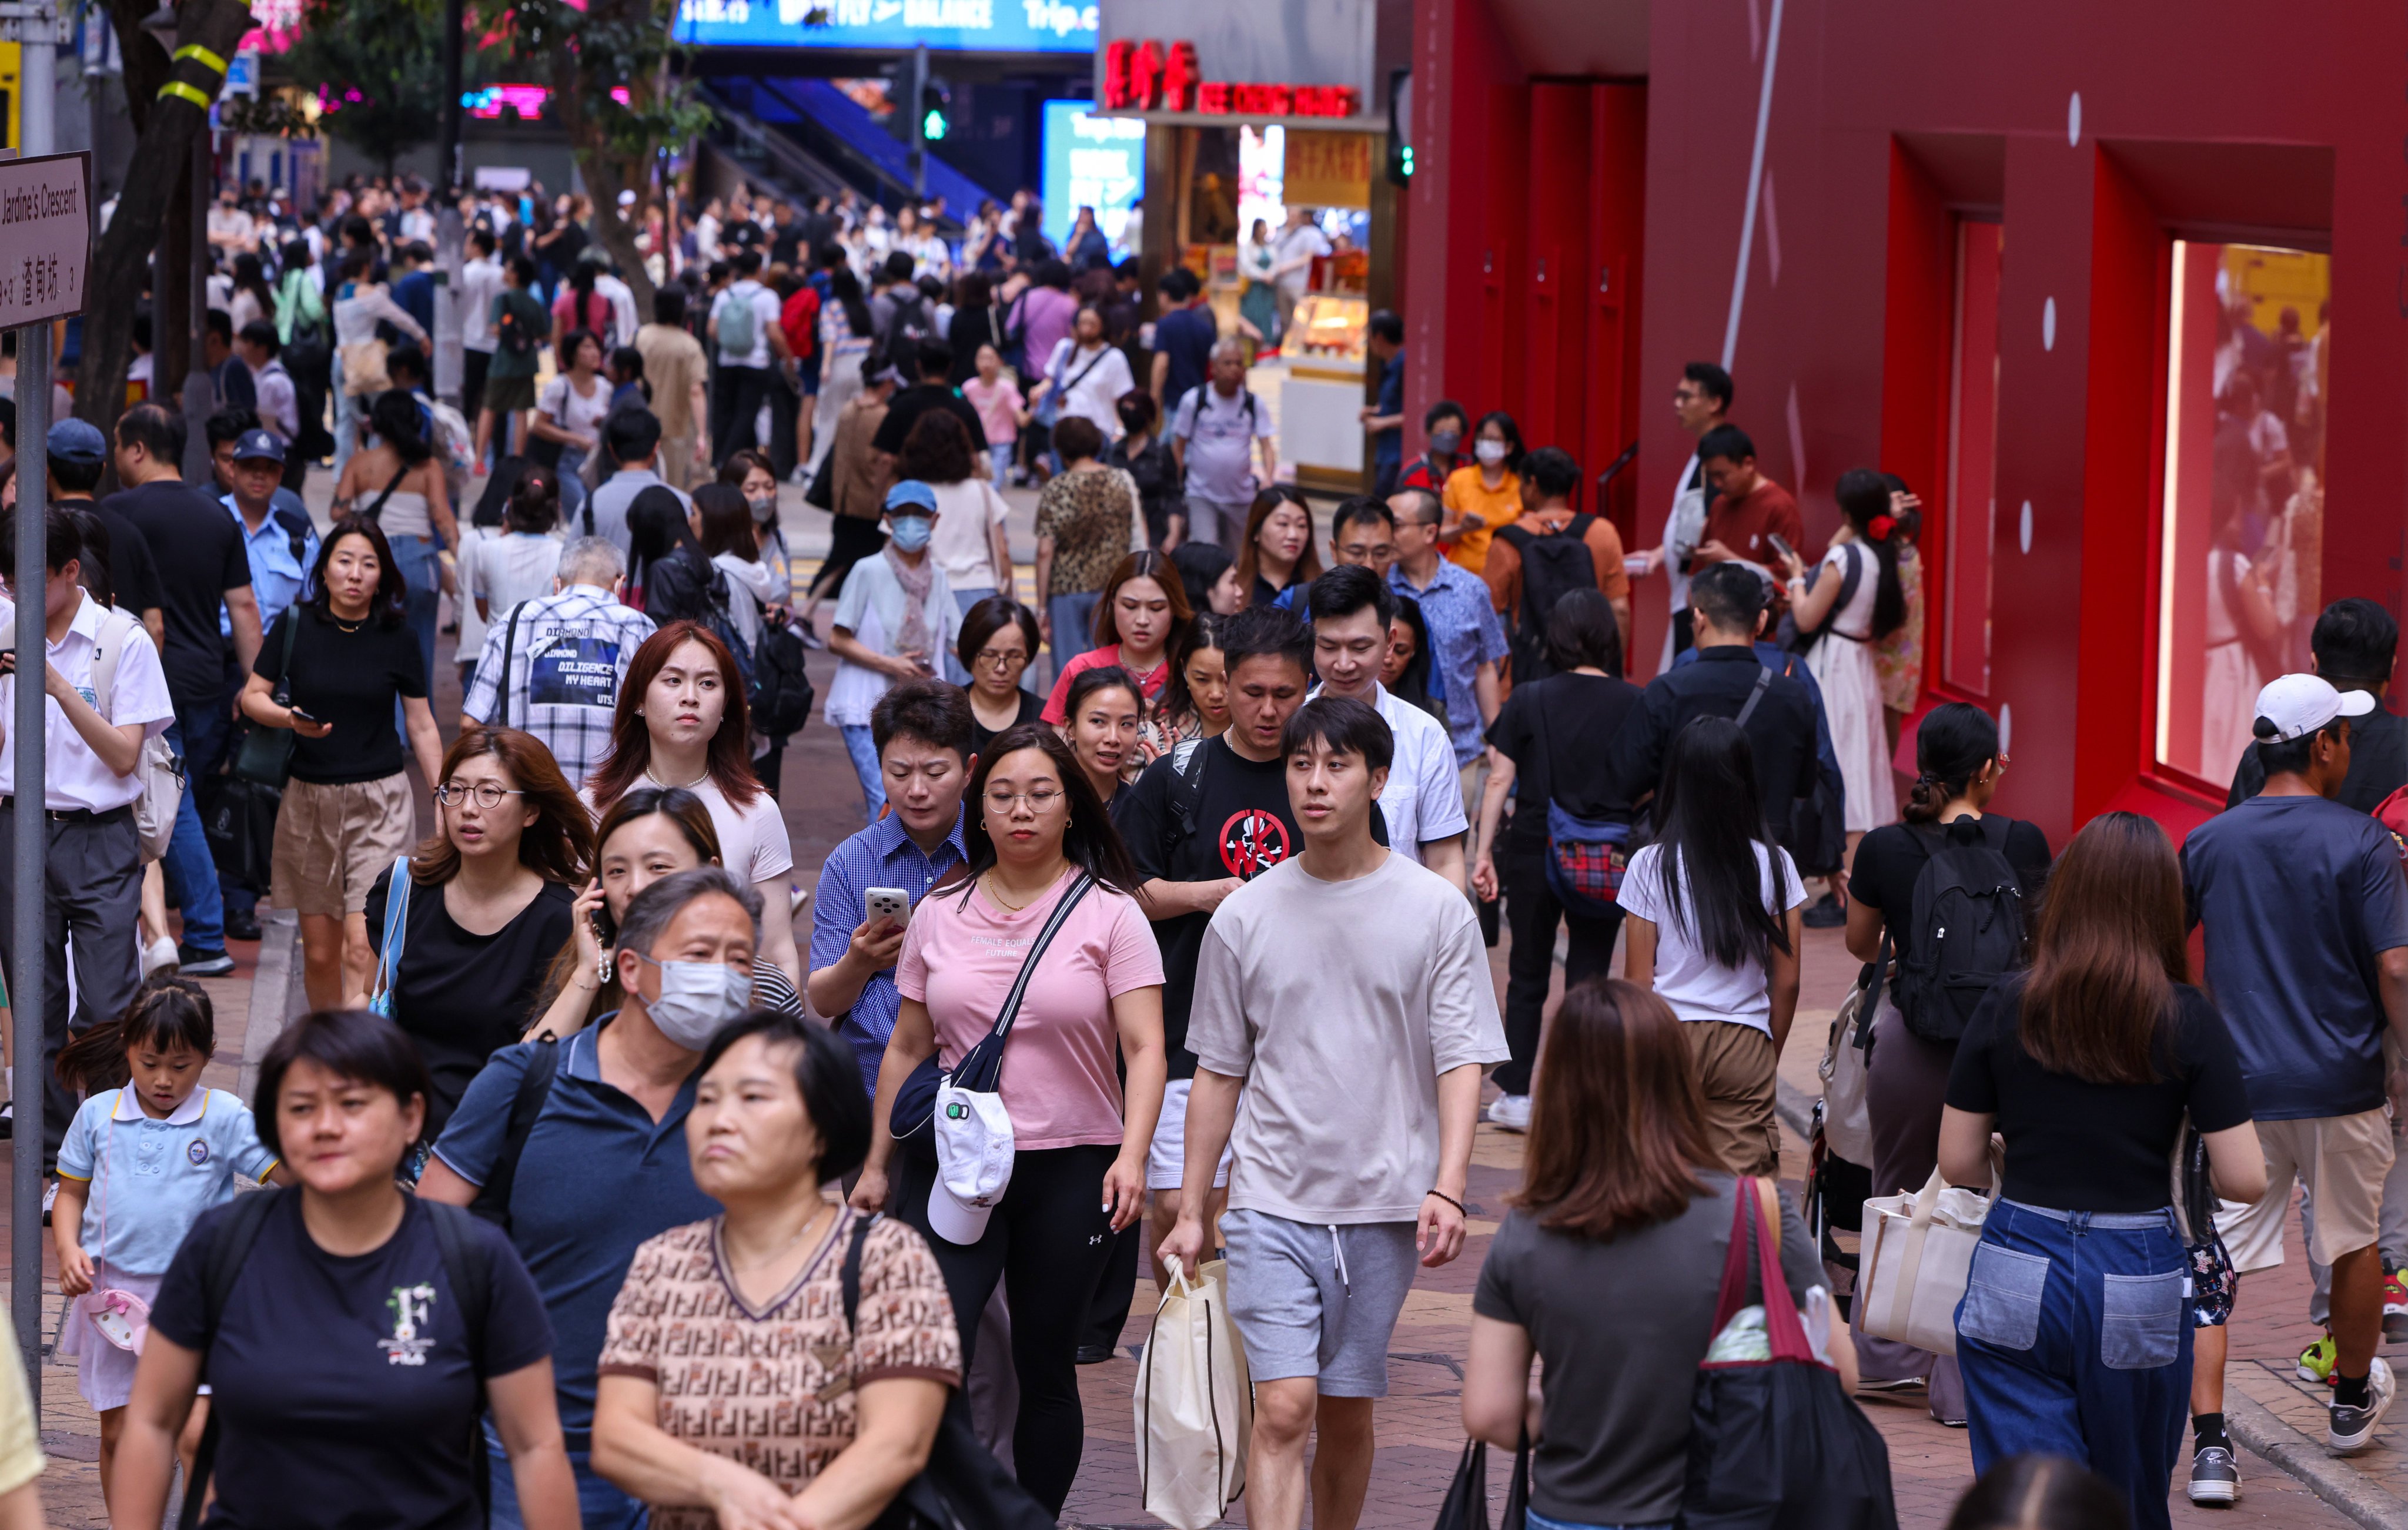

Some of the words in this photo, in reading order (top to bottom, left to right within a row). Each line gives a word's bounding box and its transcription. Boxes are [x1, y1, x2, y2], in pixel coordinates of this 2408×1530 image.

[2, 185, 38, 225] Jardine's
[41, 180, 76, 219] Crescent
[22, 252, 58, 307] 渣甸坊
[69, 266, 73, 292] 3
[546, 627, 590, 637] DIAMOND
[558, 661, 614, 675] DILIGENCE
[566, 675, 579, 685] MY
[580, 675, 612, 688] HEART
[971, 936, 1002, 947] FEMALE
[1005, 937, 1035, 948] EQUALS
